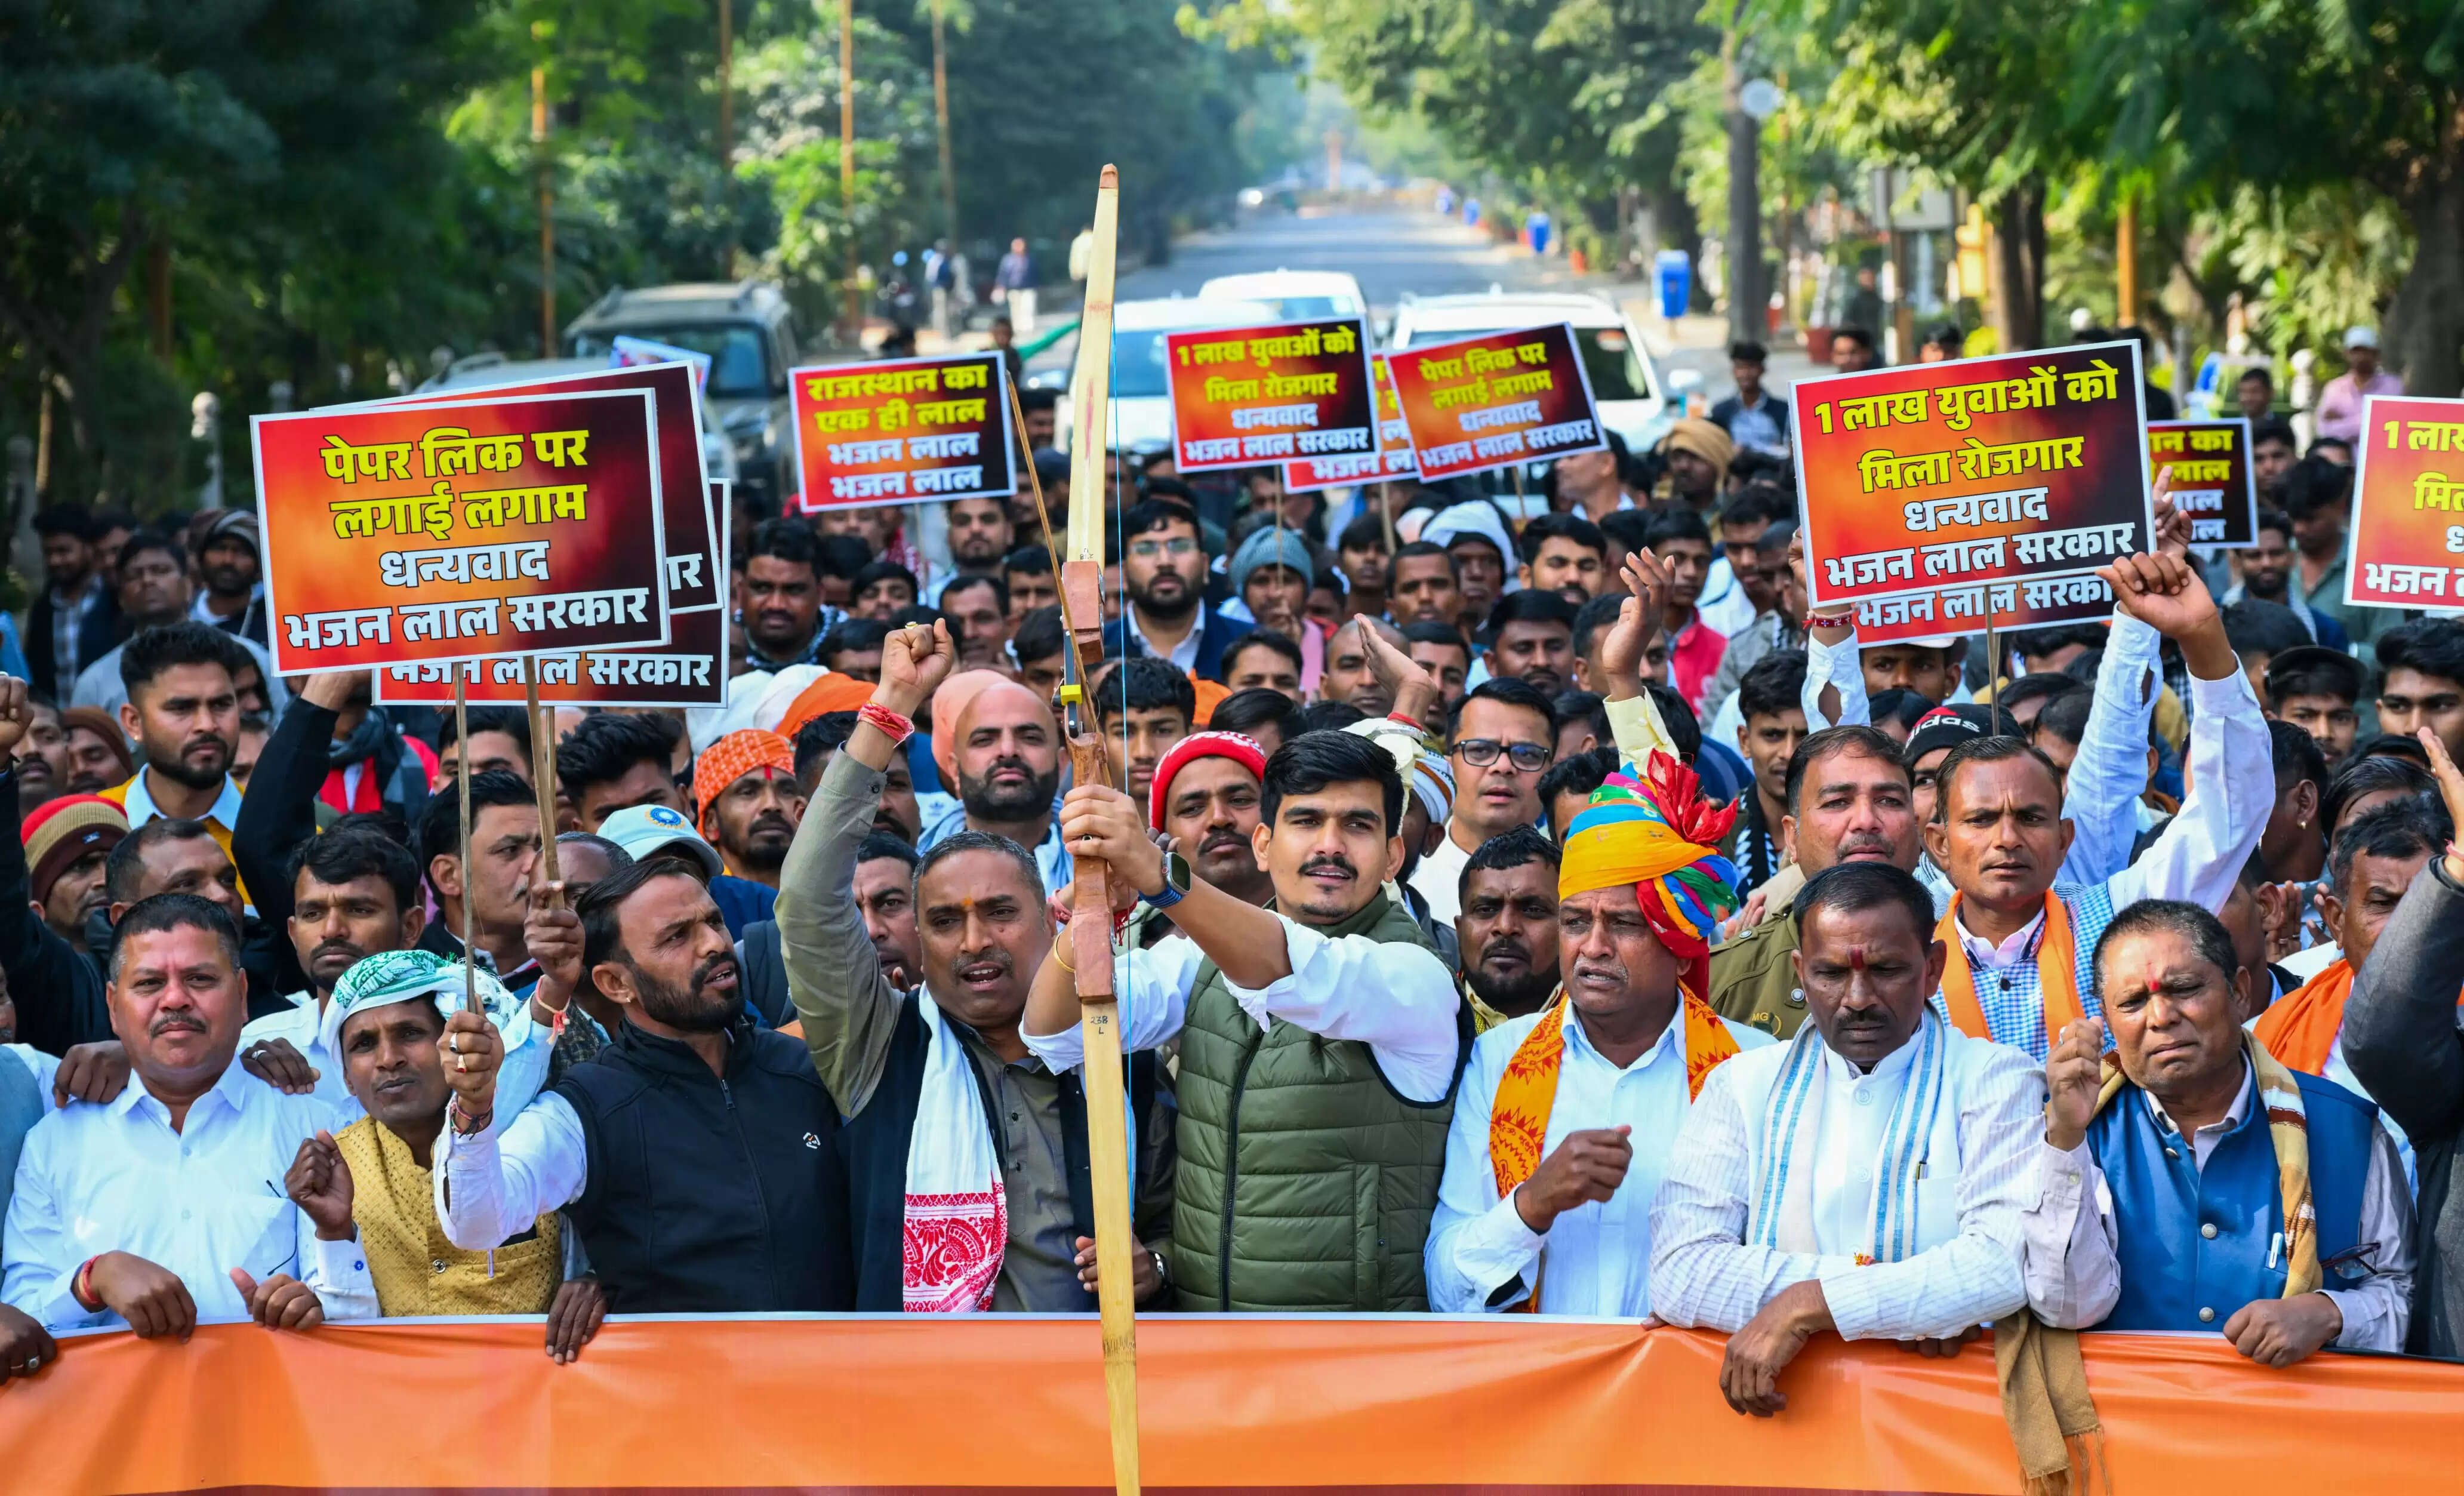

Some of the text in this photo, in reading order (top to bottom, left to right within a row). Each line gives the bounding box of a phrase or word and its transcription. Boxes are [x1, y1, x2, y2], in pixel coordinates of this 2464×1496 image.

[1177, 325, 1356, 368] 1 लाख युवाओं को
[1418, 342, 1547, 382] पेपर लिक पर
[806, 364, 988, 401] राजस्थान का
[1205, 371, 1338, 403] मिला रोजगार
[1430, 375, 1489, 410] लगाई
[1491, 370, 1553, 397] लगाम
[1814, 359, 2120, 435] 1 लाख युवाओं को
[814, 398, 987, 433] एक ही लाल
[1231, 403, 1319, 429] धन्यवाद
[1459, 399, 1543, 432] धन्यवाद
[828, 432, 980, 466] भजन लाल
[1184, 438, 1240, 461] भजन
[1242, 433, 1294, 457] लाल
[1296, 427, 1369, 453] सरकार
[1420, 441, 1473, 468] भजन
[1473, 432, 1524, 458] लाल
[1524, 418, 1594, 449] सरकार
[2188, 430, 2234, 451] का
[2383, 420, 2400, 450] 1
[320, 427, 590, 484] पेपर लिक पर
[1311, 455, 1381, 479] भजन
[1856, 436, 2086, 494] मिला रोजगार
[830, 465, 983, 498] भजन लाल
[329, 481, 589, 540] लगाई लगाम
[1904, 487, 2050, 533] धन्यवाद
[380, 540, 550, 588] धन्यवाद
[1824, 522, 2136, 589] भजन लाल सरकार
[2364, 562, 2450, 596] भजन
[283, 587, 651, 651] भजन लाल सरकार
[1857, 575, 2113, 628] भजन लाल सरका
[586, 652, 714, 687] सरकार
